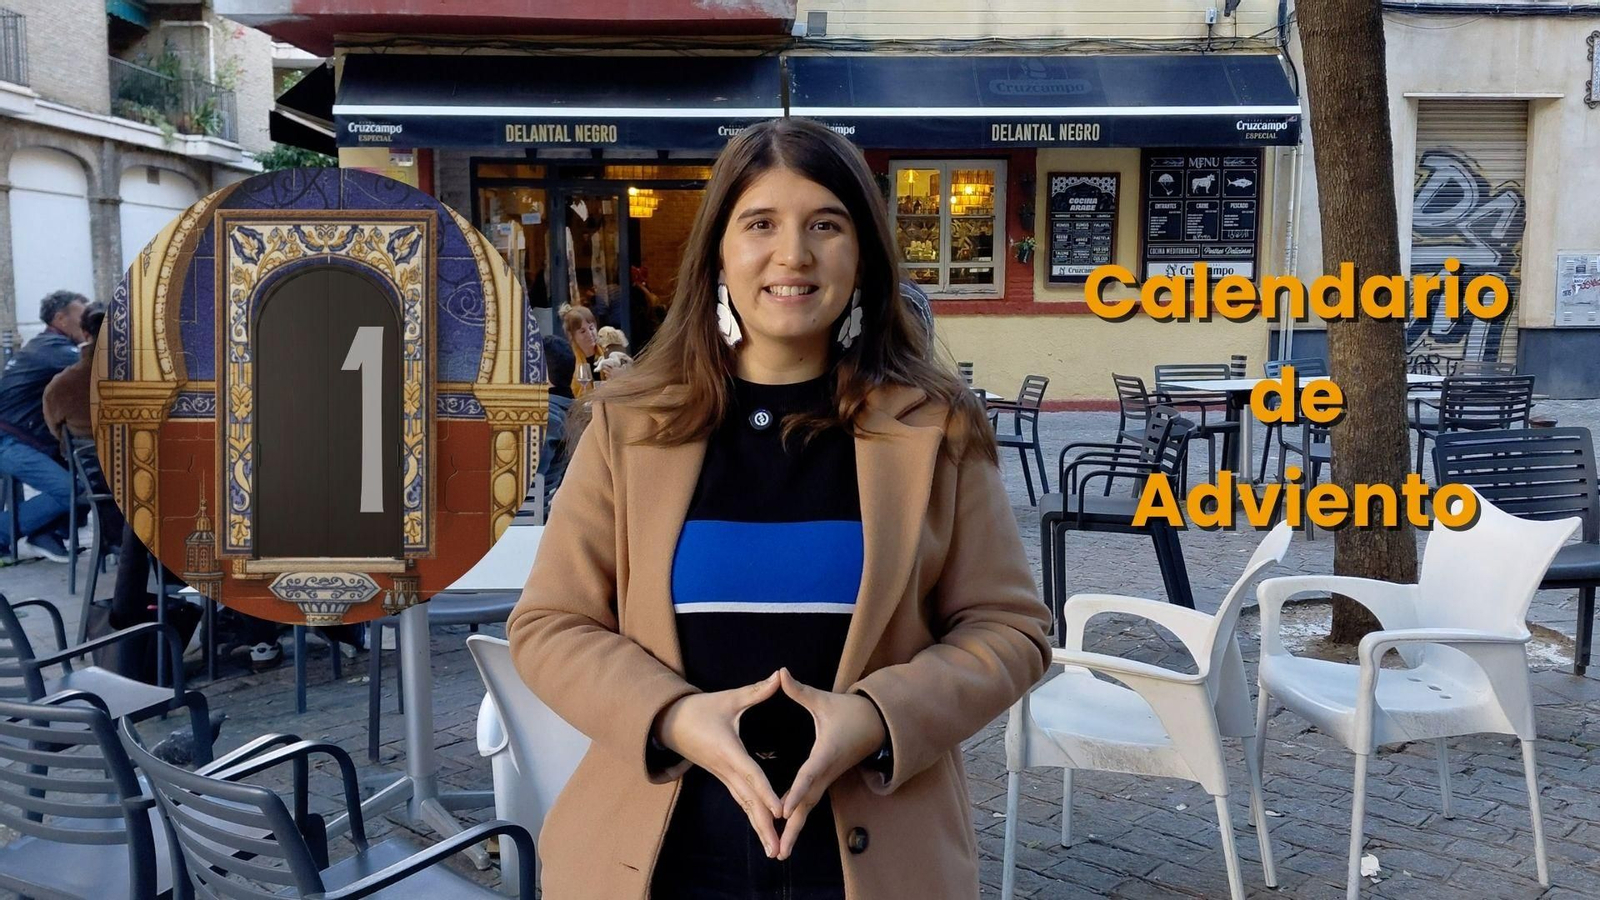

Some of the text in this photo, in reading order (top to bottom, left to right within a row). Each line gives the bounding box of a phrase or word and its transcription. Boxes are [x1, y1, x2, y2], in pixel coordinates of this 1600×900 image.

[347, 122, 403, 135] Cruzcampo
[991, 122, 1101, 142] DELANTAL NEGRO
[1236, 120, 1288, 132] Cruzcampo
[358, 134, 393, 143] ESPECIAL
[505, 124, 618, 143] DELANTAL NEGRO
[1245, 132, 1279, 140] ESPECIAL
[1188, 157, 1220, 169] MENU
[1068, 197, 1098, 205] COCINA
